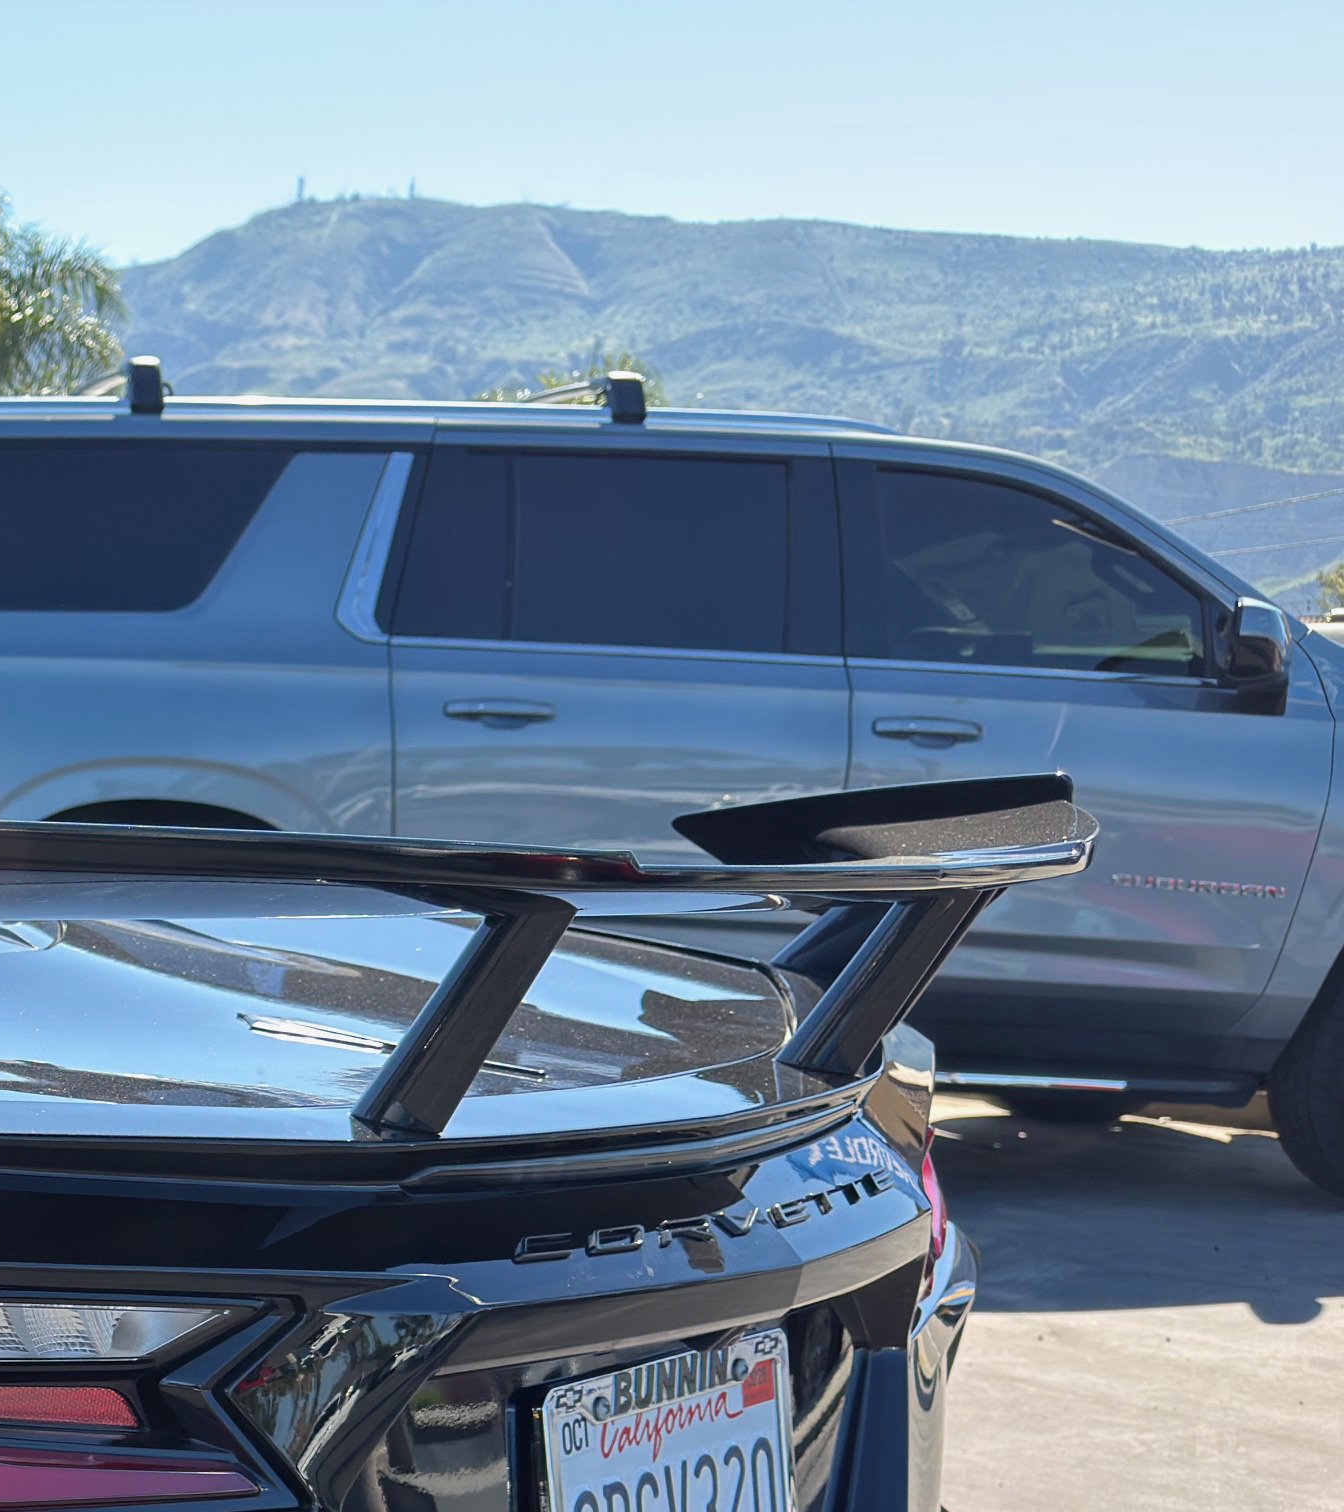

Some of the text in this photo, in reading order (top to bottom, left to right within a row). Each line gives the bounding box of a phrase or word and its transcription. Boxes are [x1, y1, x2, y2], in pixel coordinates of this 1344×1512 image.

[512, 1167, 897, 1264] CORVETTE
[612, 1346, 729, 1415] BUNNIN
[562, 1391, 743, 1462] OCT California
